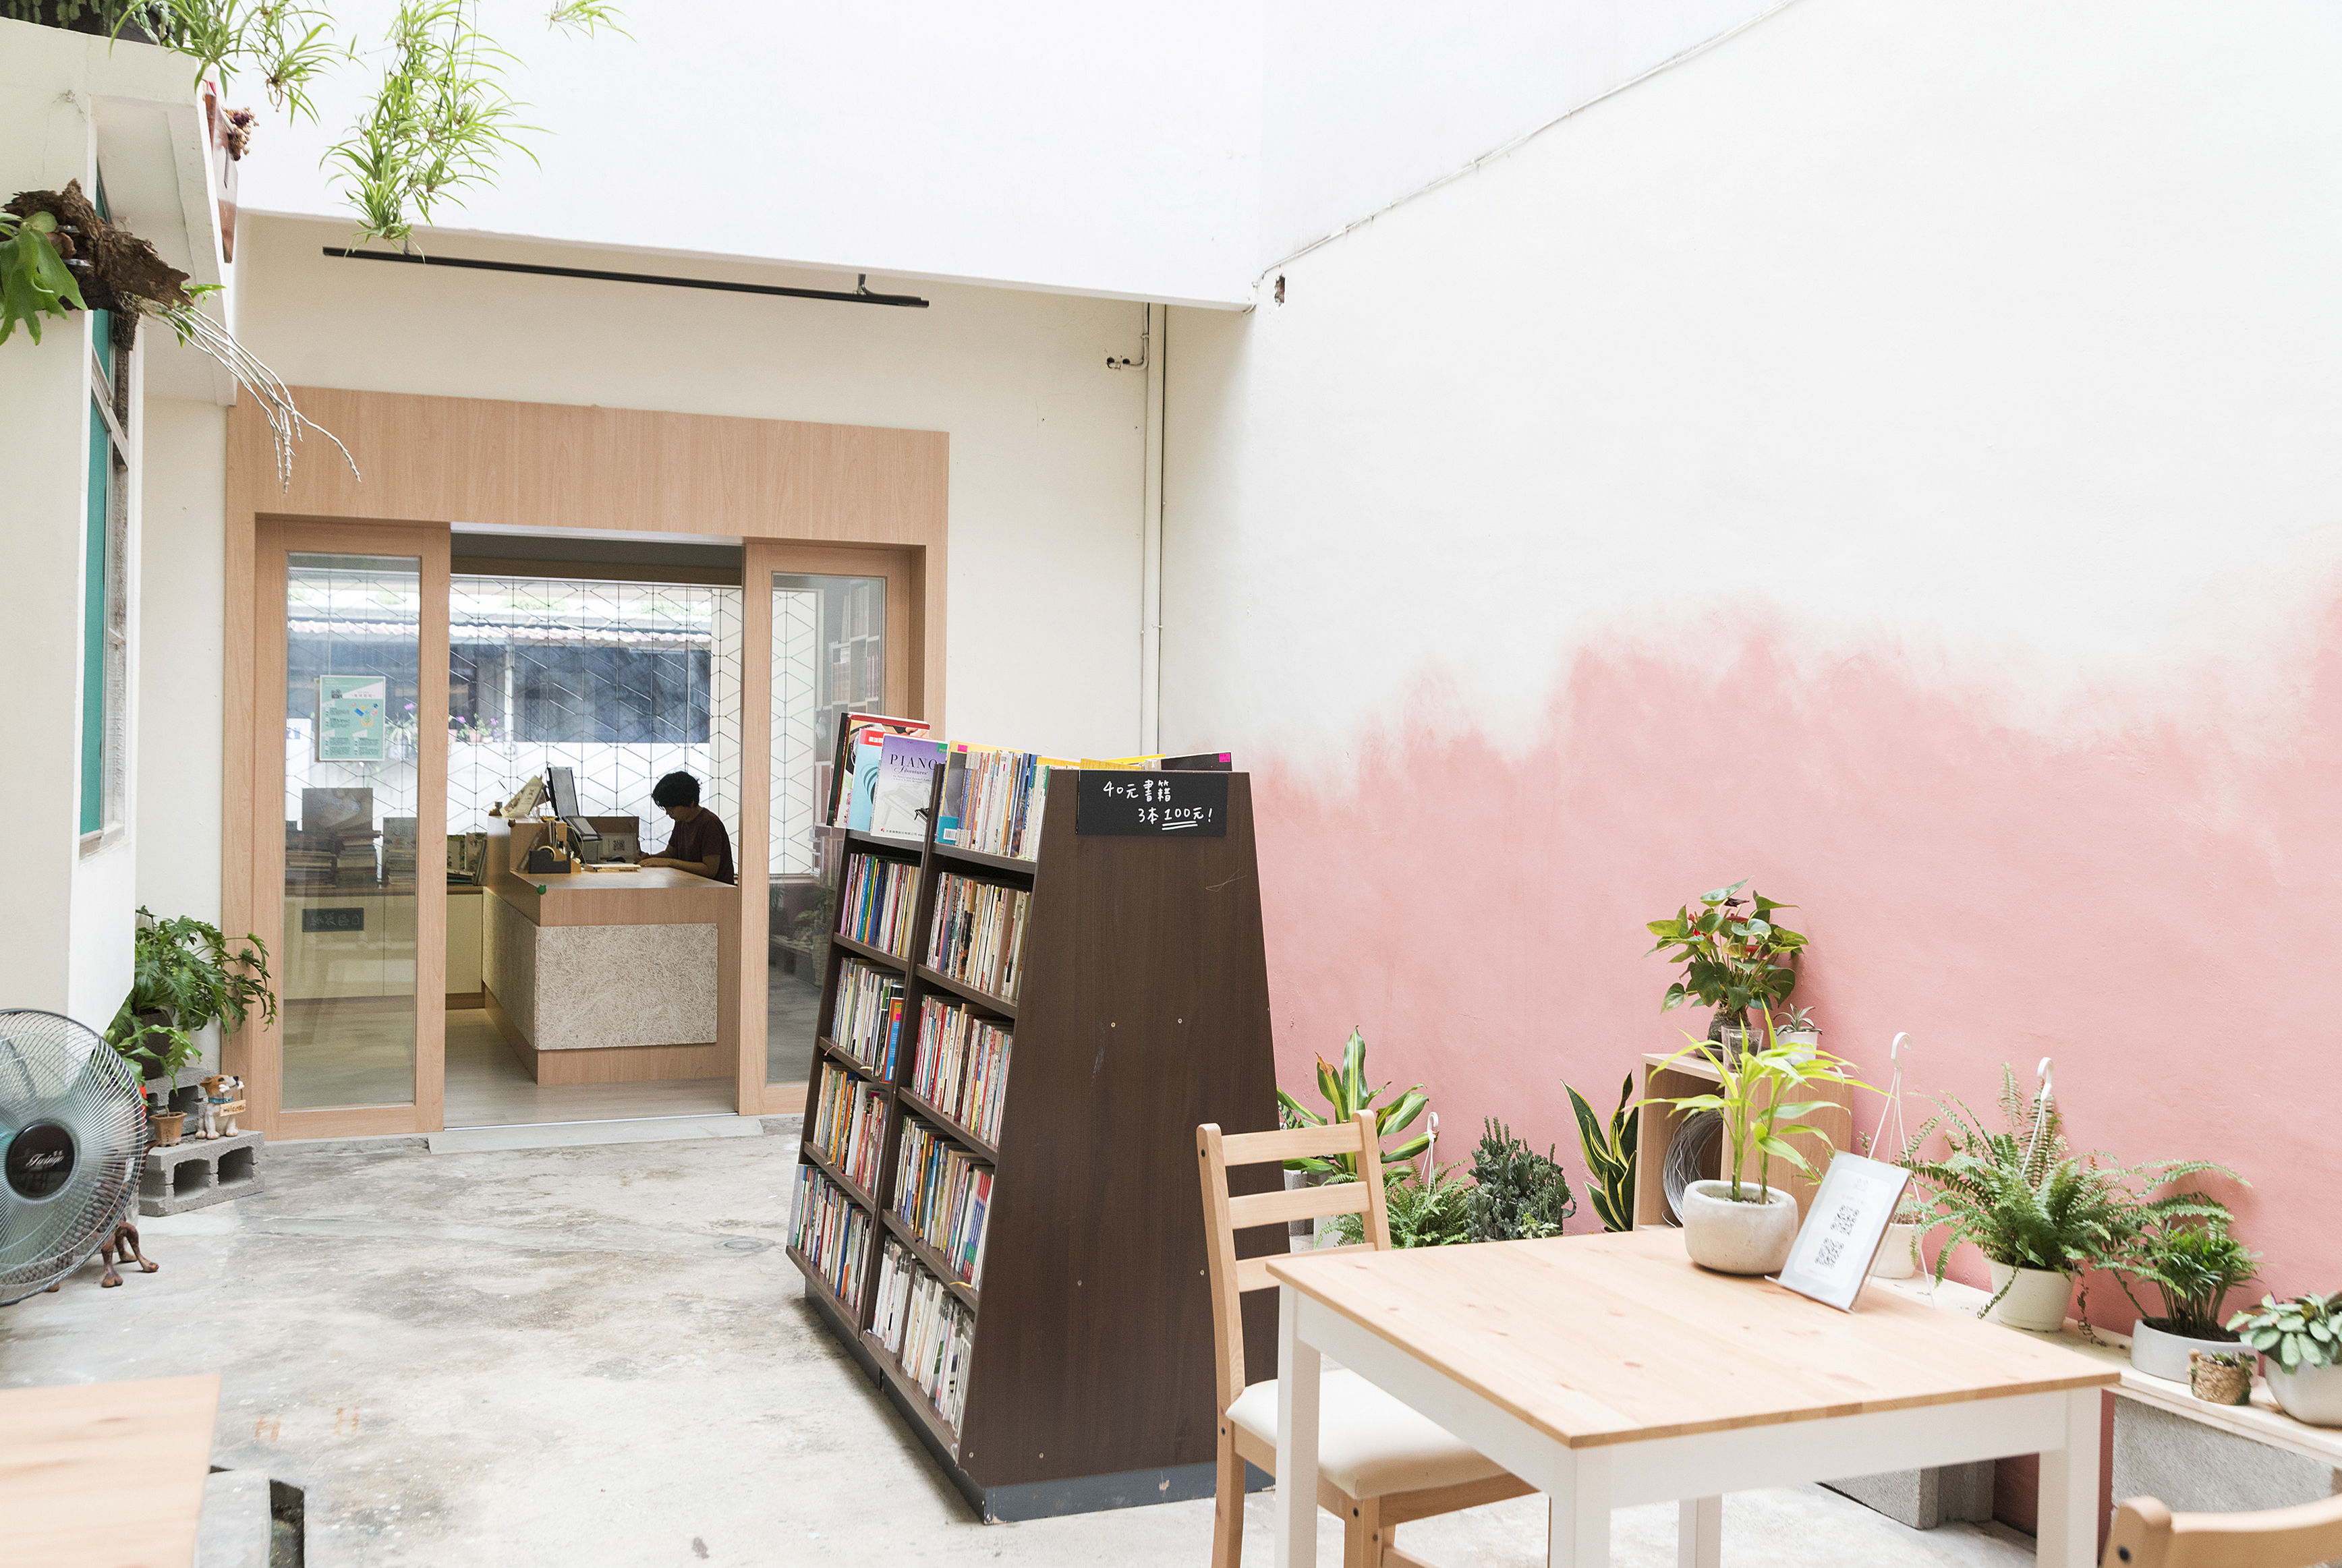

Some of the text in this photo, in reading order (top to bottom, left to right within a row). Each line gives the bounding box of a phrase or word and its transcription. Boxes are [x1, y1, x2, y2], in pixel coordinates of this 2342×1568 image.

[890, 754, 938, 770] PIANO
[893, 766, 927, 775] Adventures
[1103, 779, 1172, 803] 40元書籍
